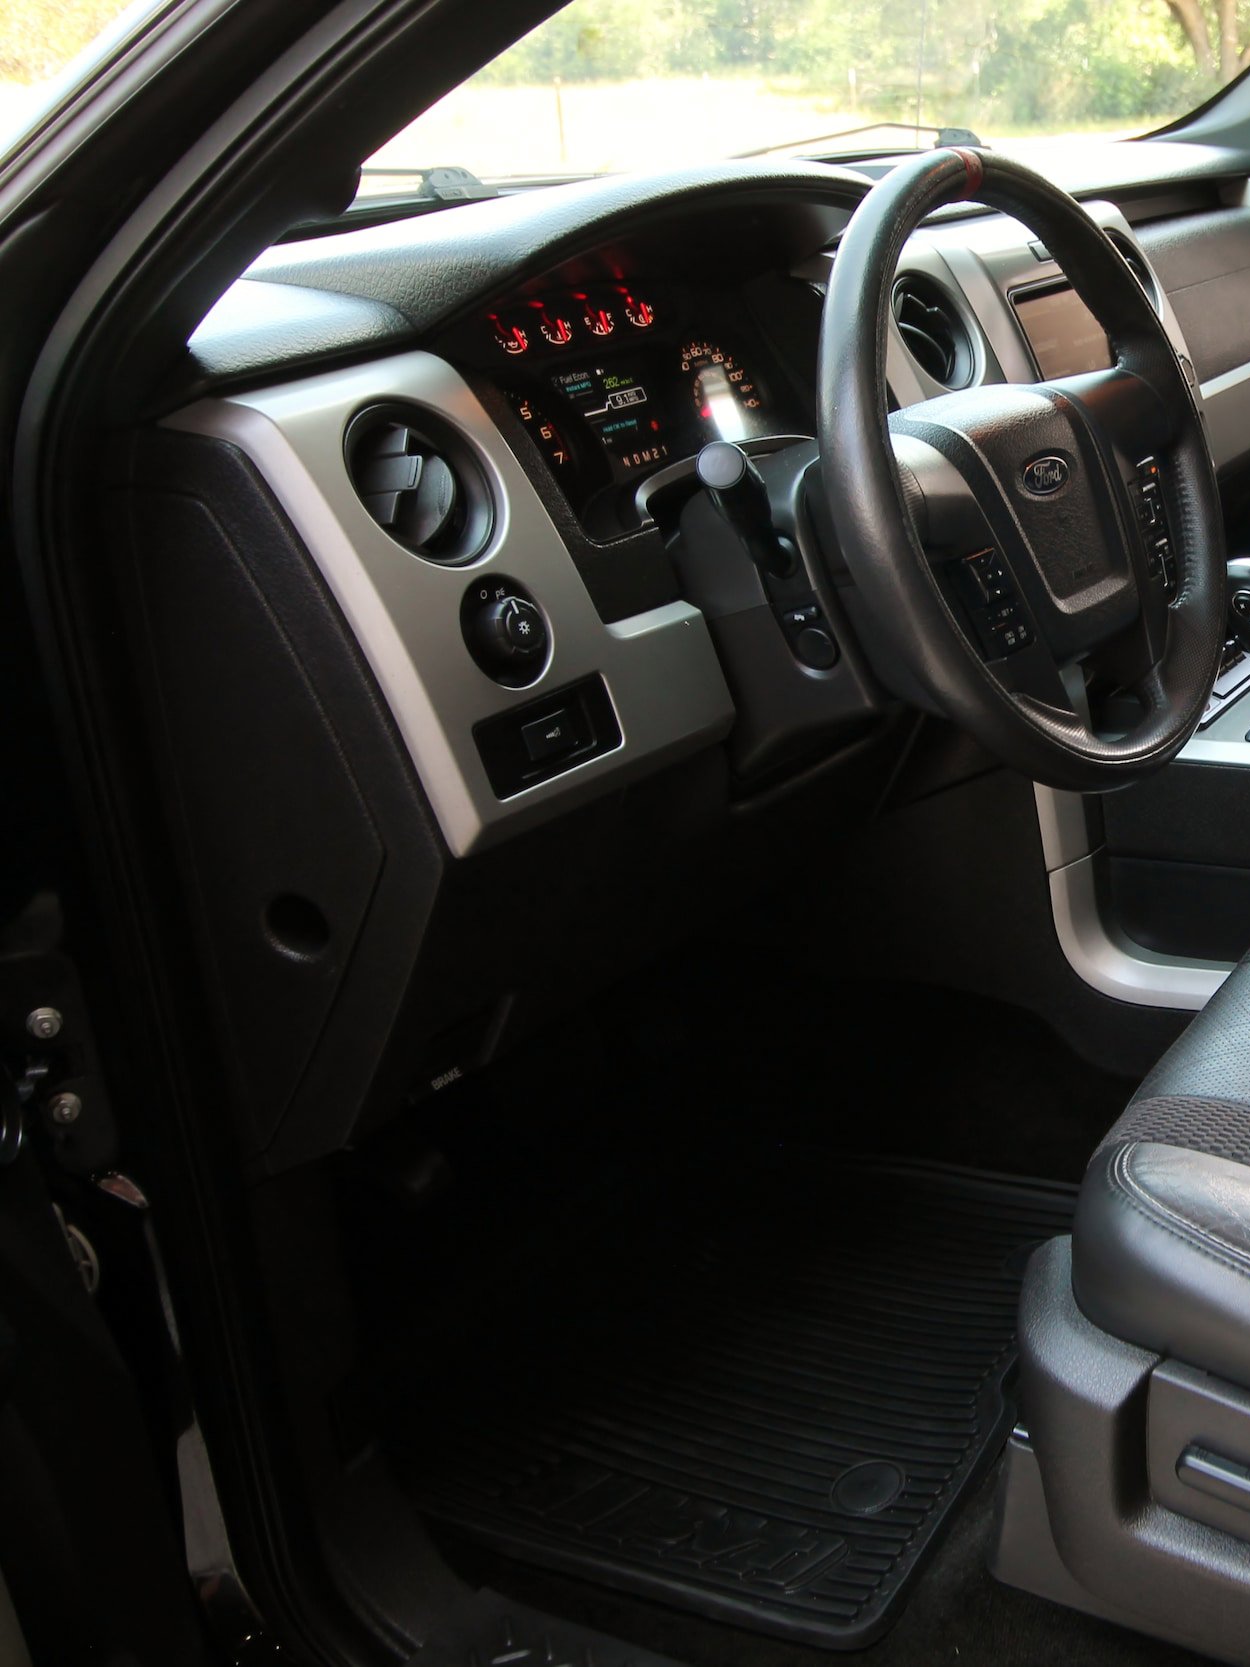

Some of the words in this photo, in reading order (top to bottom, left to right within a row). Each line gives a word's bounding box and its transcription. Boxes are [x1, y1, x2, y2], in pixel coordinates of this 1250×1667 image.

[711, 353, 724, 364] 80
[603, 376, 620, 389] 262
[616, 394, 629, 406] 9.1
[520, 407, 532, 420] 5
[540, 426, 552, 440] 6
[553, 451, 563, 464] 7
[1033, 461, 1062, 489] Ford
[430, 1067, 463, 1090] BRAKE
